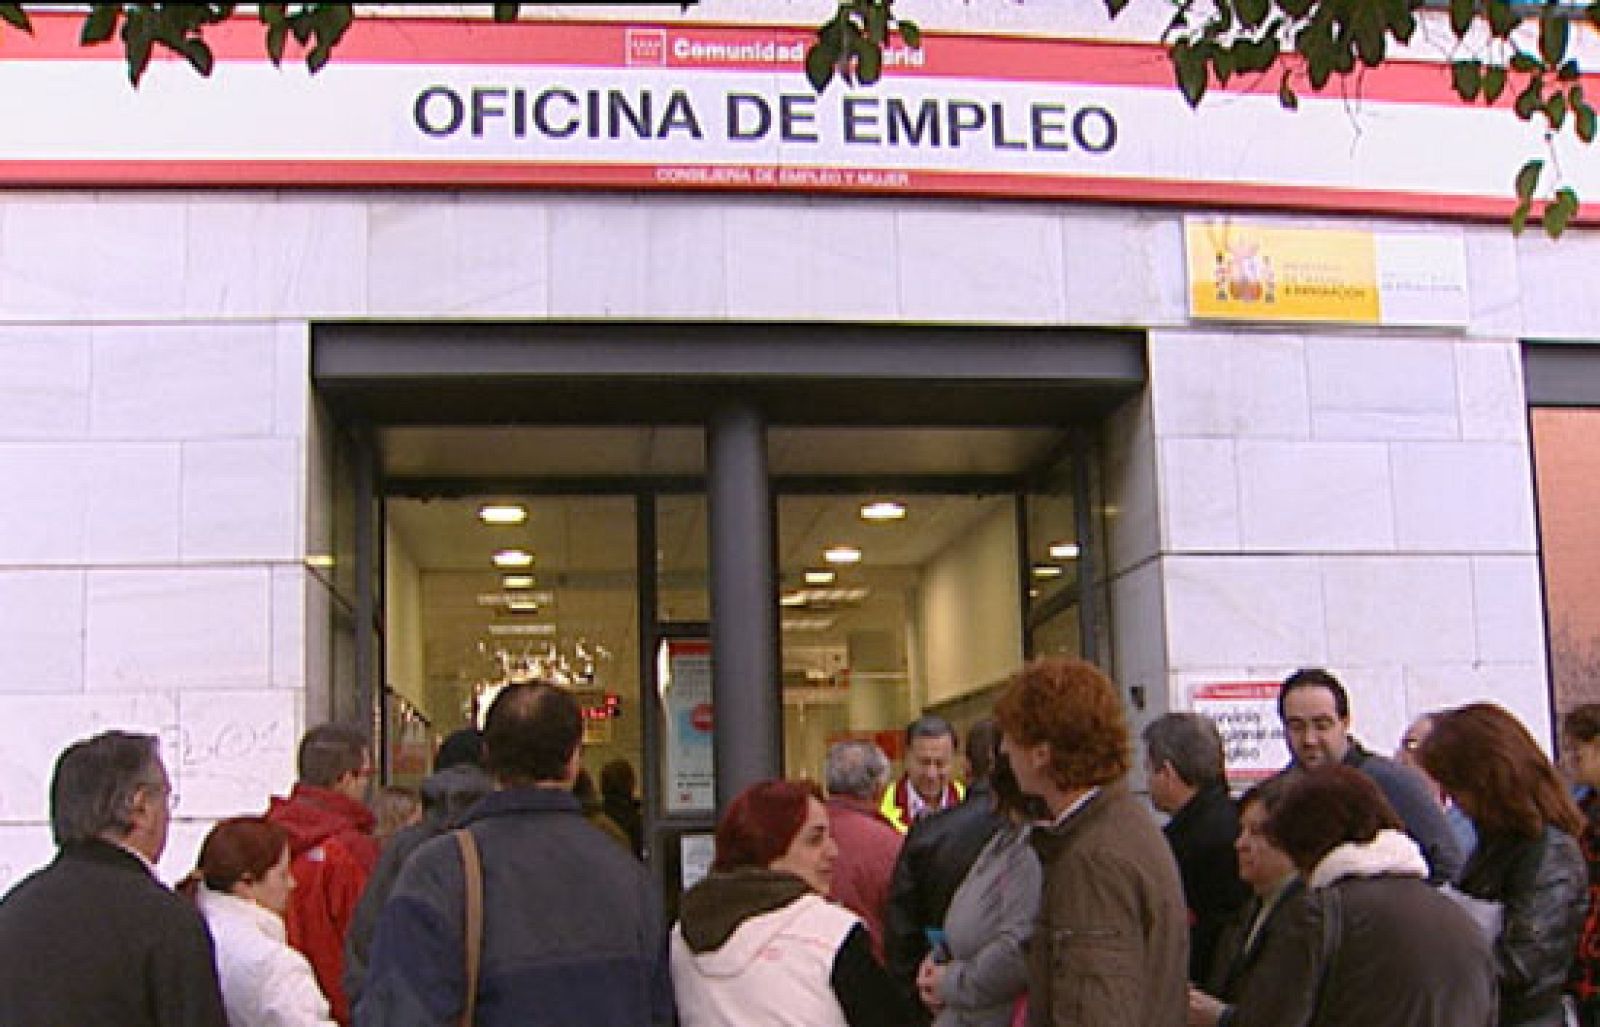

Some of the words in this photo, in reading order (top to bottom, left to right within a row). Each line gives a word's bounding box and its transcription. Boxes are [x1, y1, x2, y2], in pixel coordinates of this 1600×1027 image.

[674, 38, 805, 65] Comunidad
[413, 85, 703, 139] OFICINA
[726, 92, 818, 143] DE
[843, 95, 1118, 154] EMPLEO
